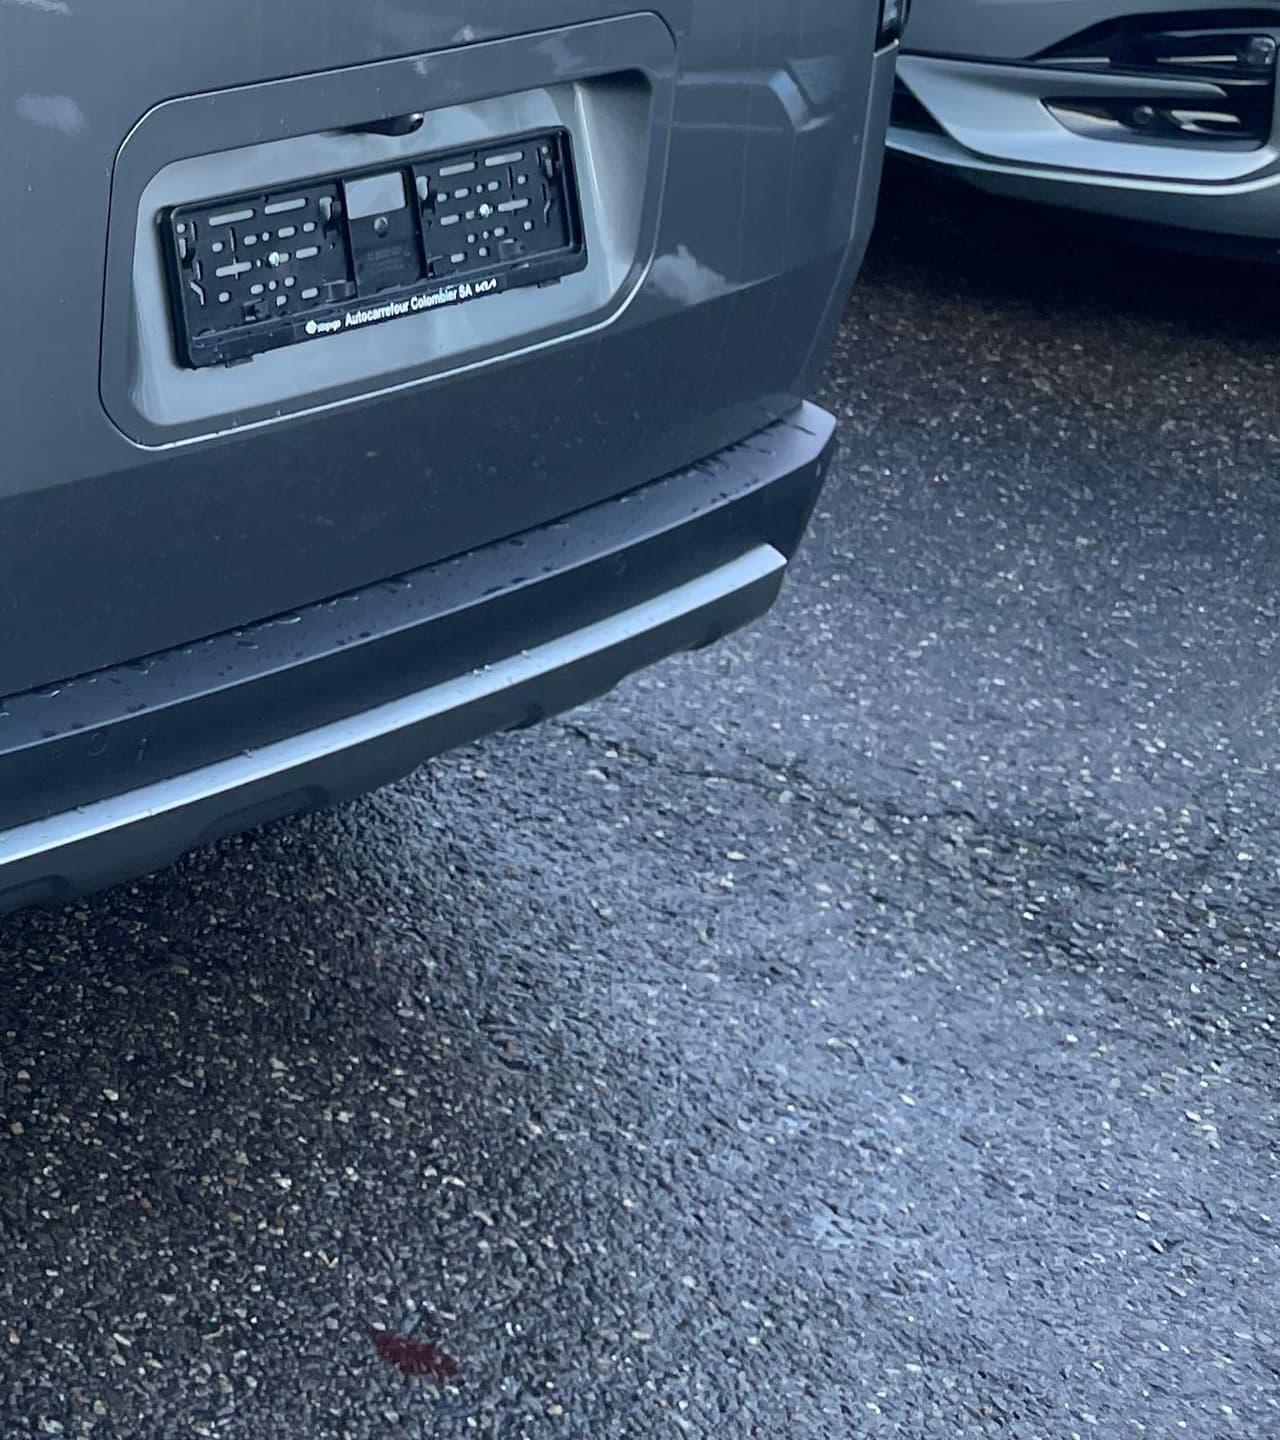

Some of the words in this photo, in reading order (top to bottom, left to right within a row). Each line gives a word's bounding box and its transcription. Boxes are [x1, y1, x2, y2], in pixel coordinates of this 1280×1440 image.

[345, 300, 410, 327] Autocarrefour
[410, 287, 458, 311] Colombier
[459, 284, 473, 298] SA
